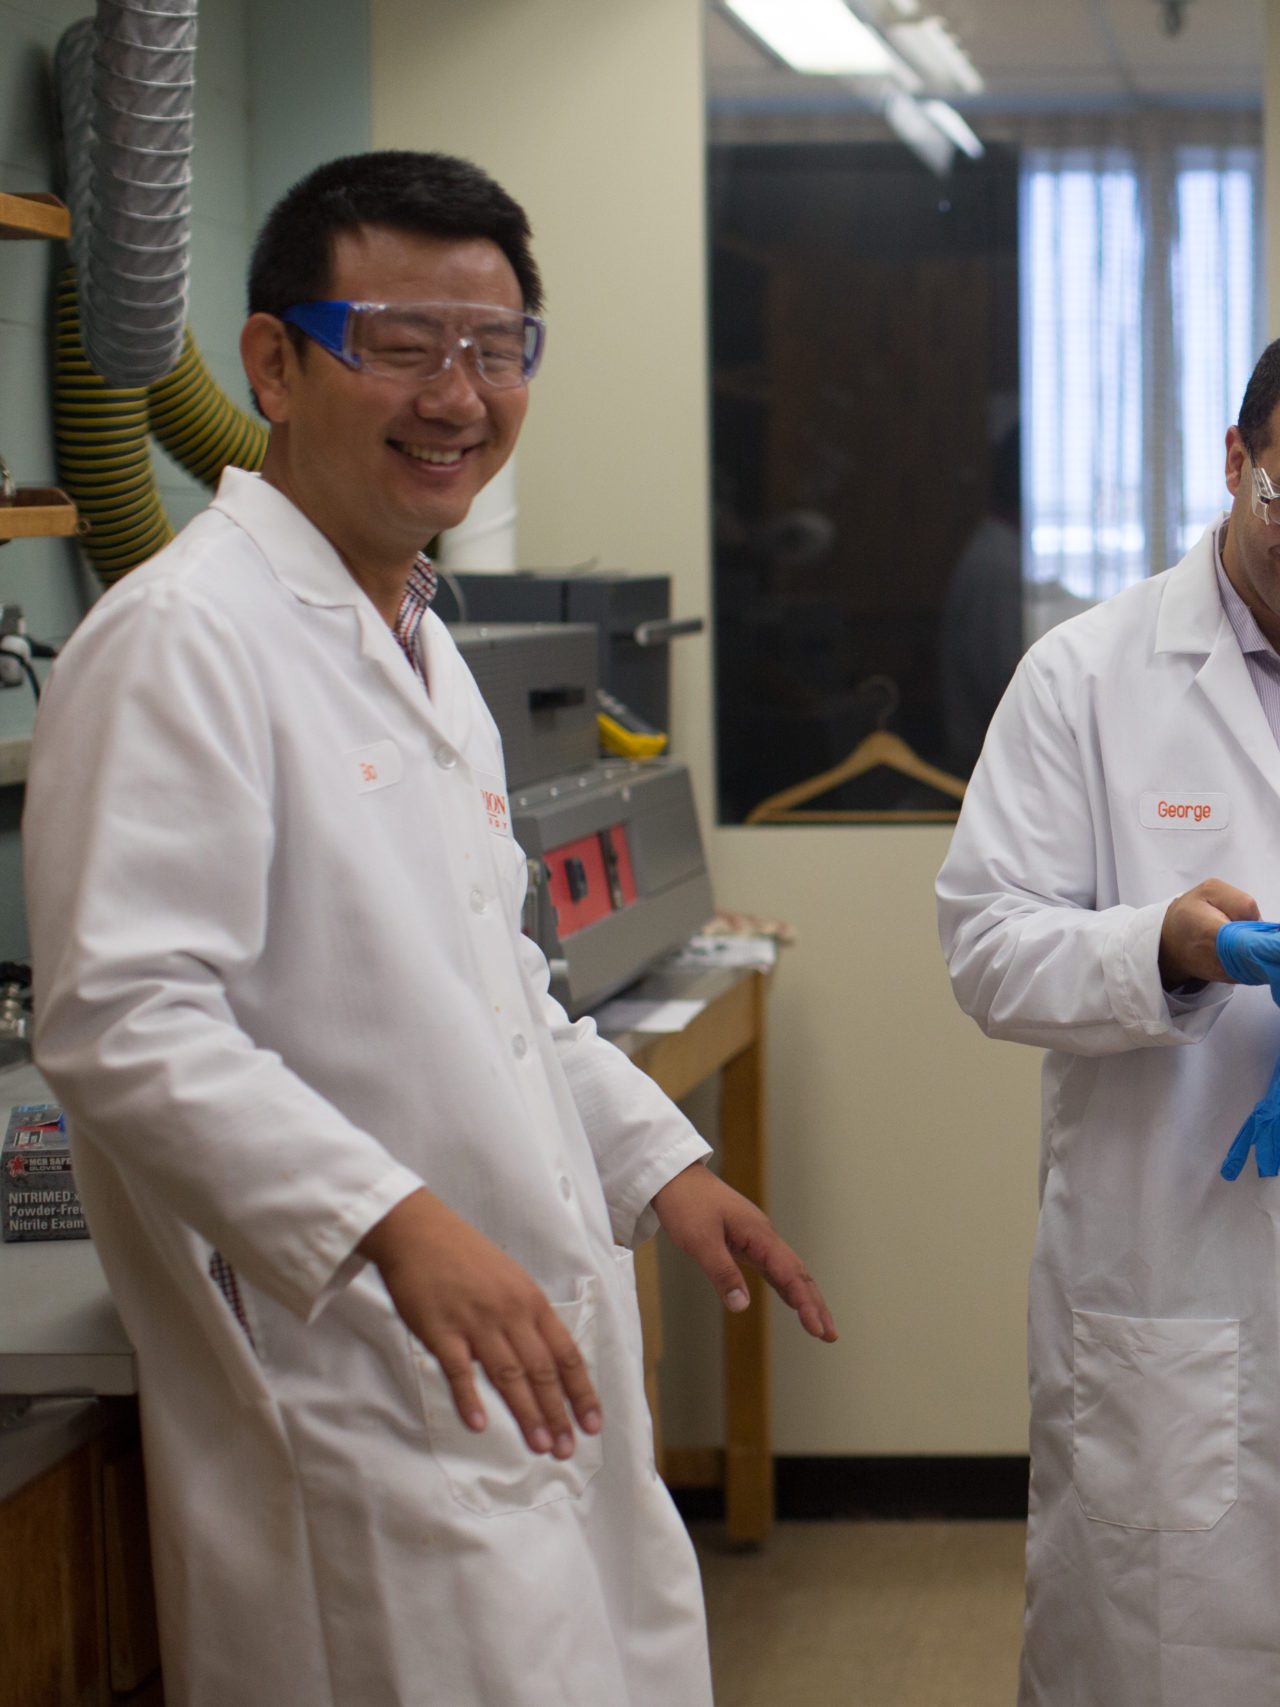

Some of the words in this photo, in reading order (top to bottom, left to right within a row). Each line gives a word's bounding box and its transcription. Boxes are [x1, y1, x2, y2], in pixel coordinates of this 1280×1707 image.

[1158, 801, 1211, 822] George
[8, 1191, 71, 1204] NITRIMED
[9, 1219, 48, 1231] Nitrile
[51, 1218, 84, 1229] Exam
